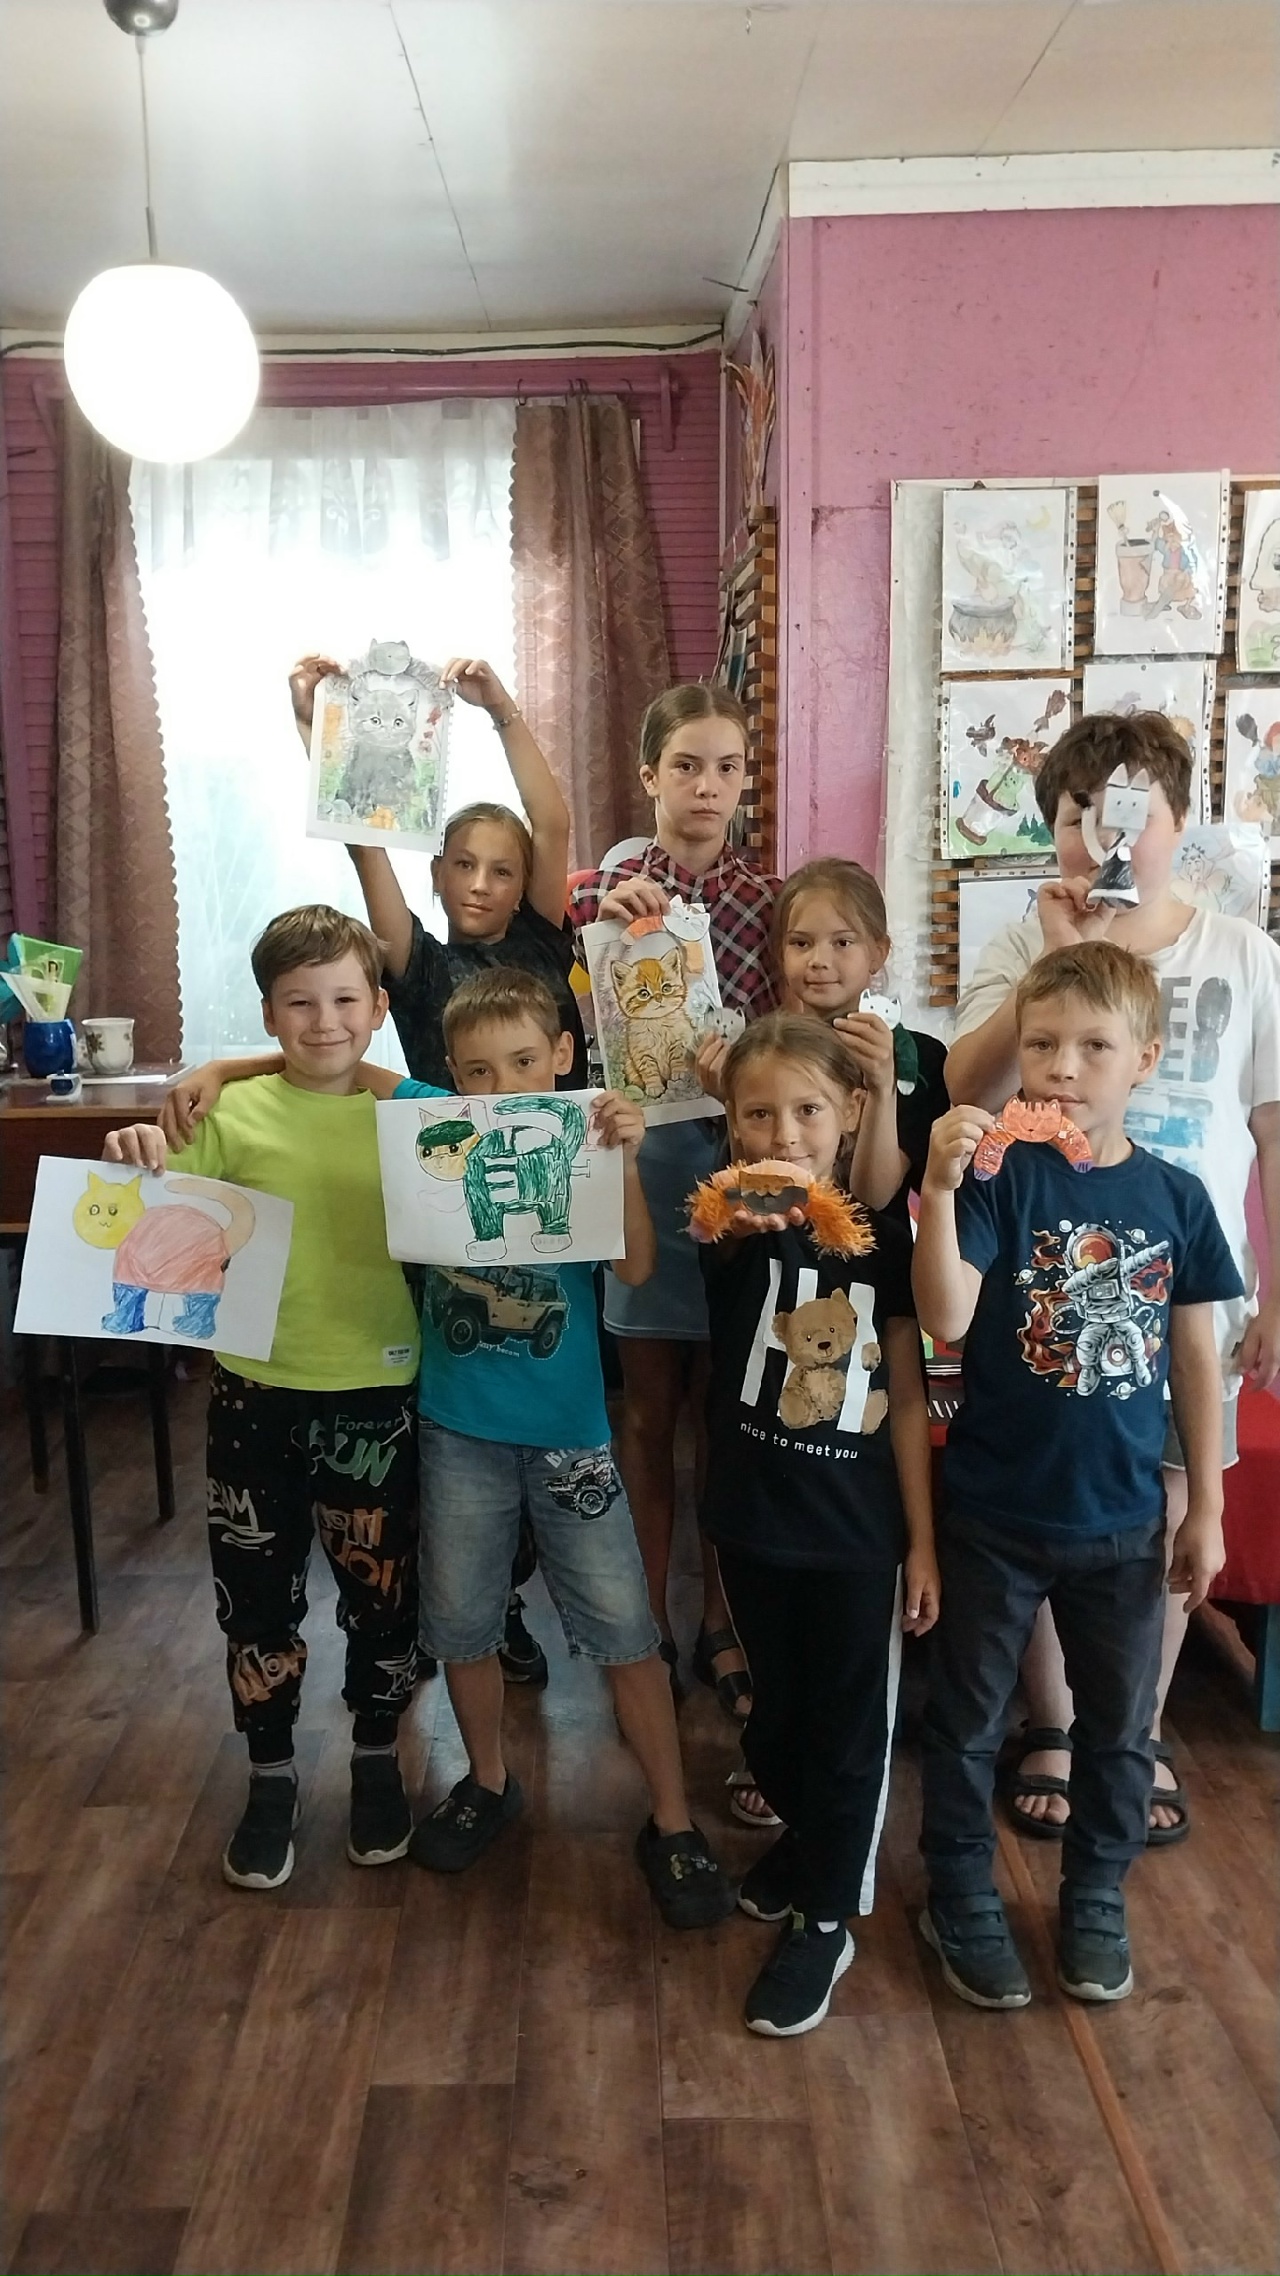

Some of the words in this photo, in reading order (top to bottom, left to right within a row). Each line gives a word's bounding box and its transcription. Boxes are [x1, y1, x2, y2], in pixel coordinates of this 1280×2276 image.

[334, 1413, 404, 1431] Forever
[740, 1421, 766, 1441] nice
[773, 1433, 788, 1448] to
[794, 1440, 831, 1458] meet
[835, 1447, 859, 1460] you
